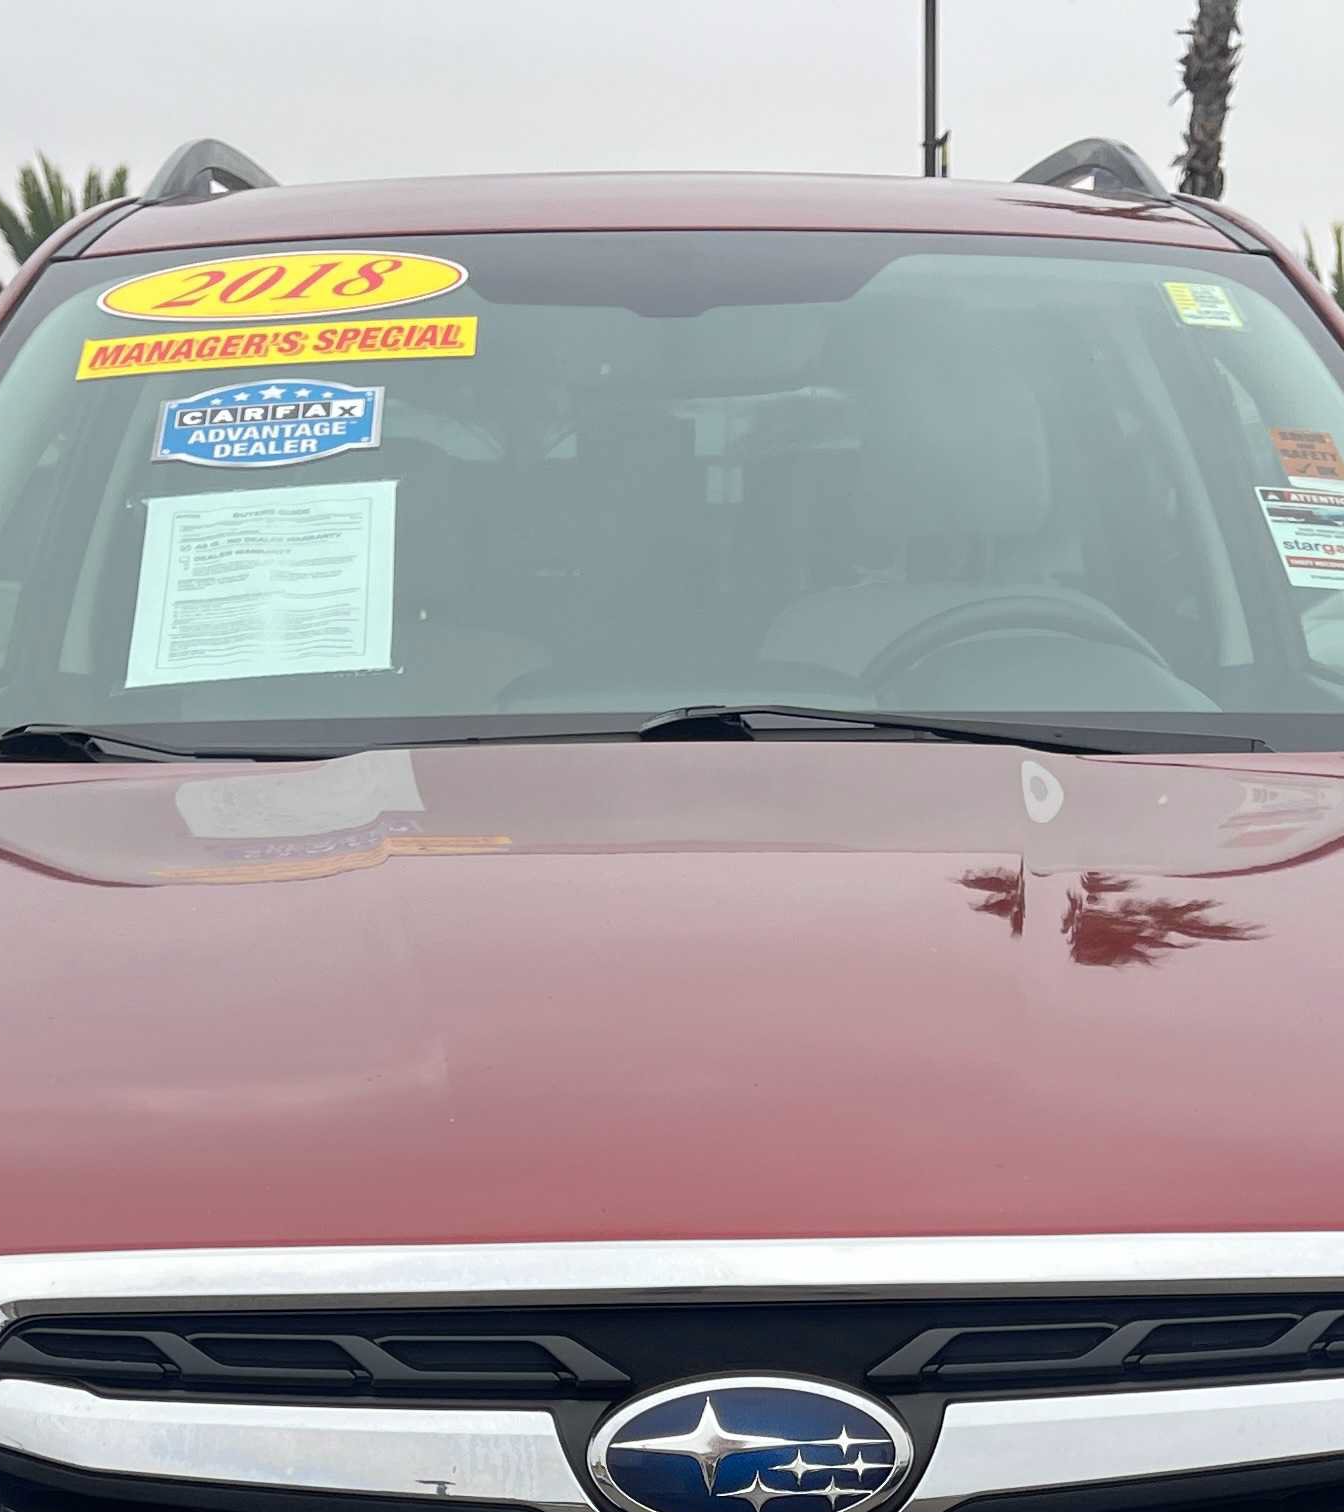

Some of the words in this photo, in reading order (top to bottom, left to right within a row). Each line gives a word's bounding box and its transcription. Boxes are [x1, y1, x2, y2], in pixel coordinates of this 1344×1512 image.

[152, 258, 403, 310] 2018
[88, 331, 308, 370] MANAGER'S
[313, 323, 464, 355] SPECIAL
[176, 399, 364, 427] CARFAX
[187, 422, 346, 446] ADVANTAGE
[213, 438, 318, 460] DEALER
